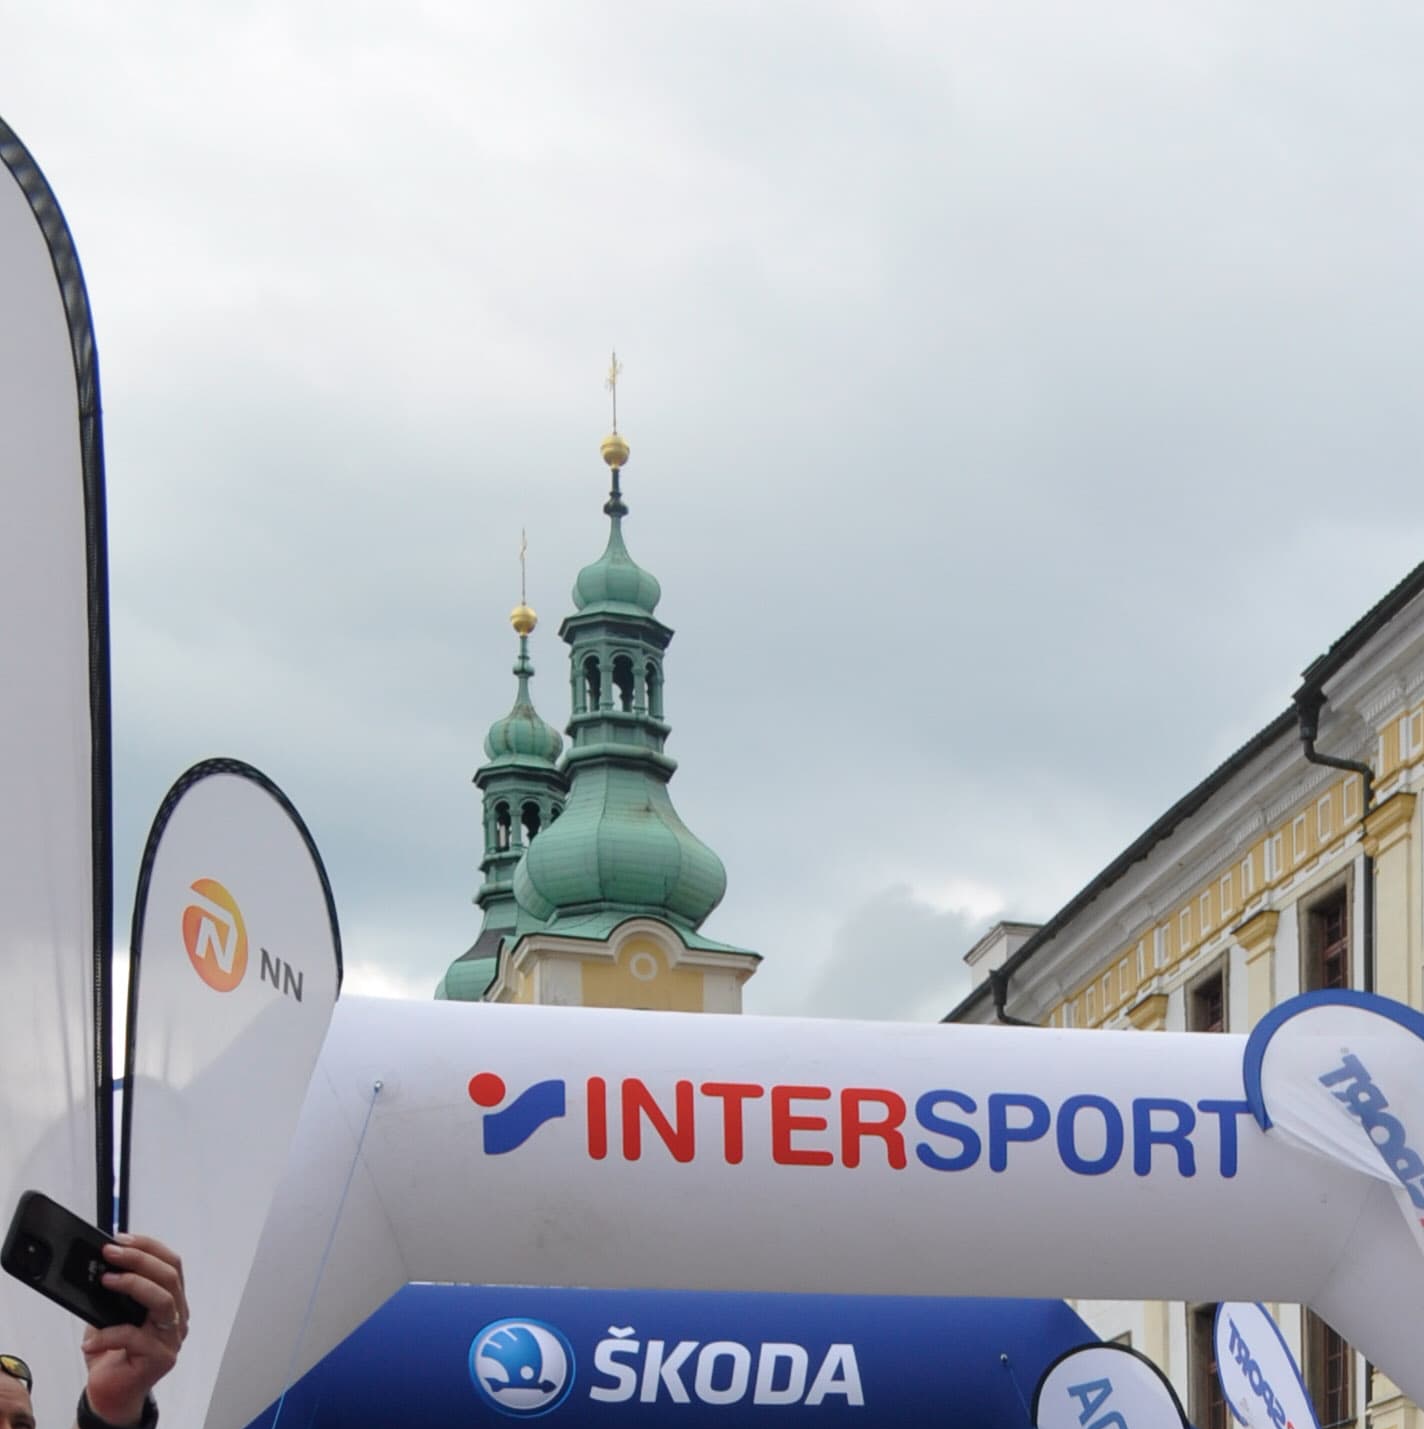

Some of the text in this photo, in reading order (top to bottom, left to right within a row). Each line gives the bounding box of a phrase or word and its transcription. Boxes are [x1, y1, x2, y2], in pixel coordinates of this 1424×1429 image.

[260, 947, 303, 1002] NN
[587, 1075, 1258, 1179] INTERSPORT
[591, 1326, 865, 1406] ŠKODA
